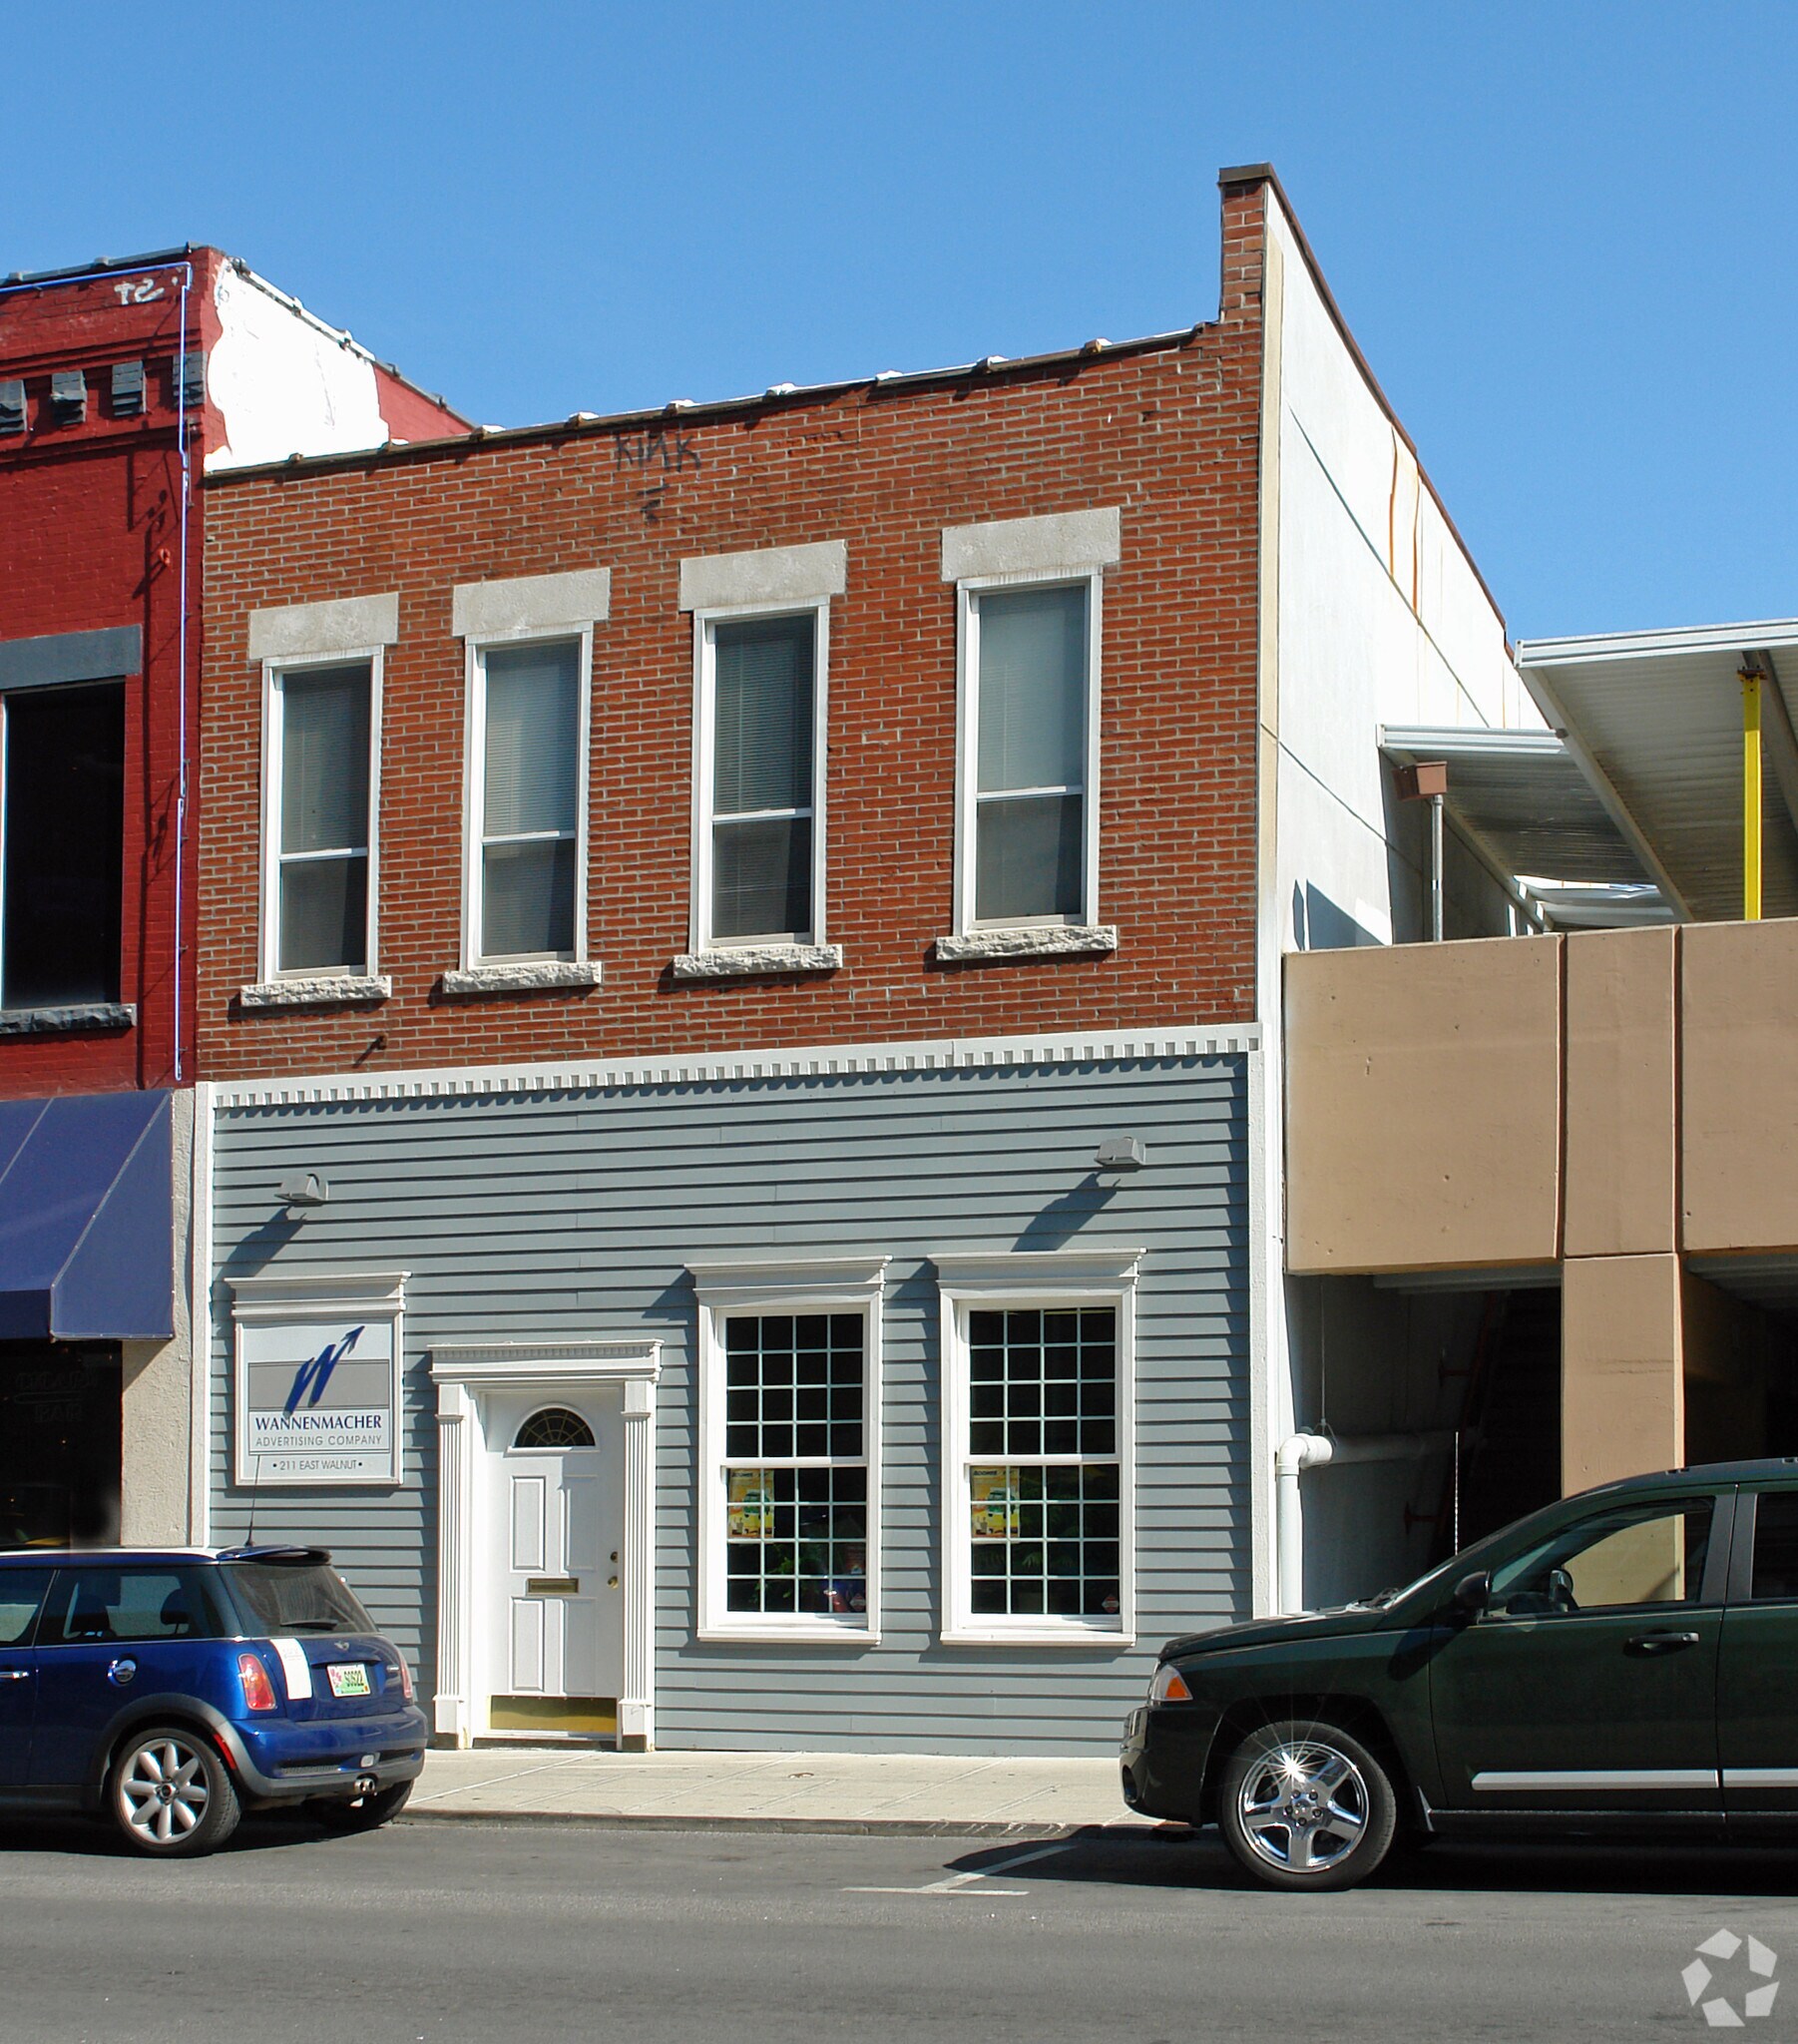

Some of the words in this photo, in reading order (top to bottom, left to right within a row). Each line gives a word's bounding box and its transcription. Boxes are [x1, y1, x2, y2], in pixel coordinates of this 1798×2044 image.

[255, 1415, 382, 1430] WANNENMACHER
[255, 1436, 323, 1447] ADVERTISING
[327, 1435, 382, 1445] COMPANY
[279, 1460, 296, 1470] 211
[299, 1460, 319, 1470] EAST
[321, 1460, 357, 1470] WALNUT
